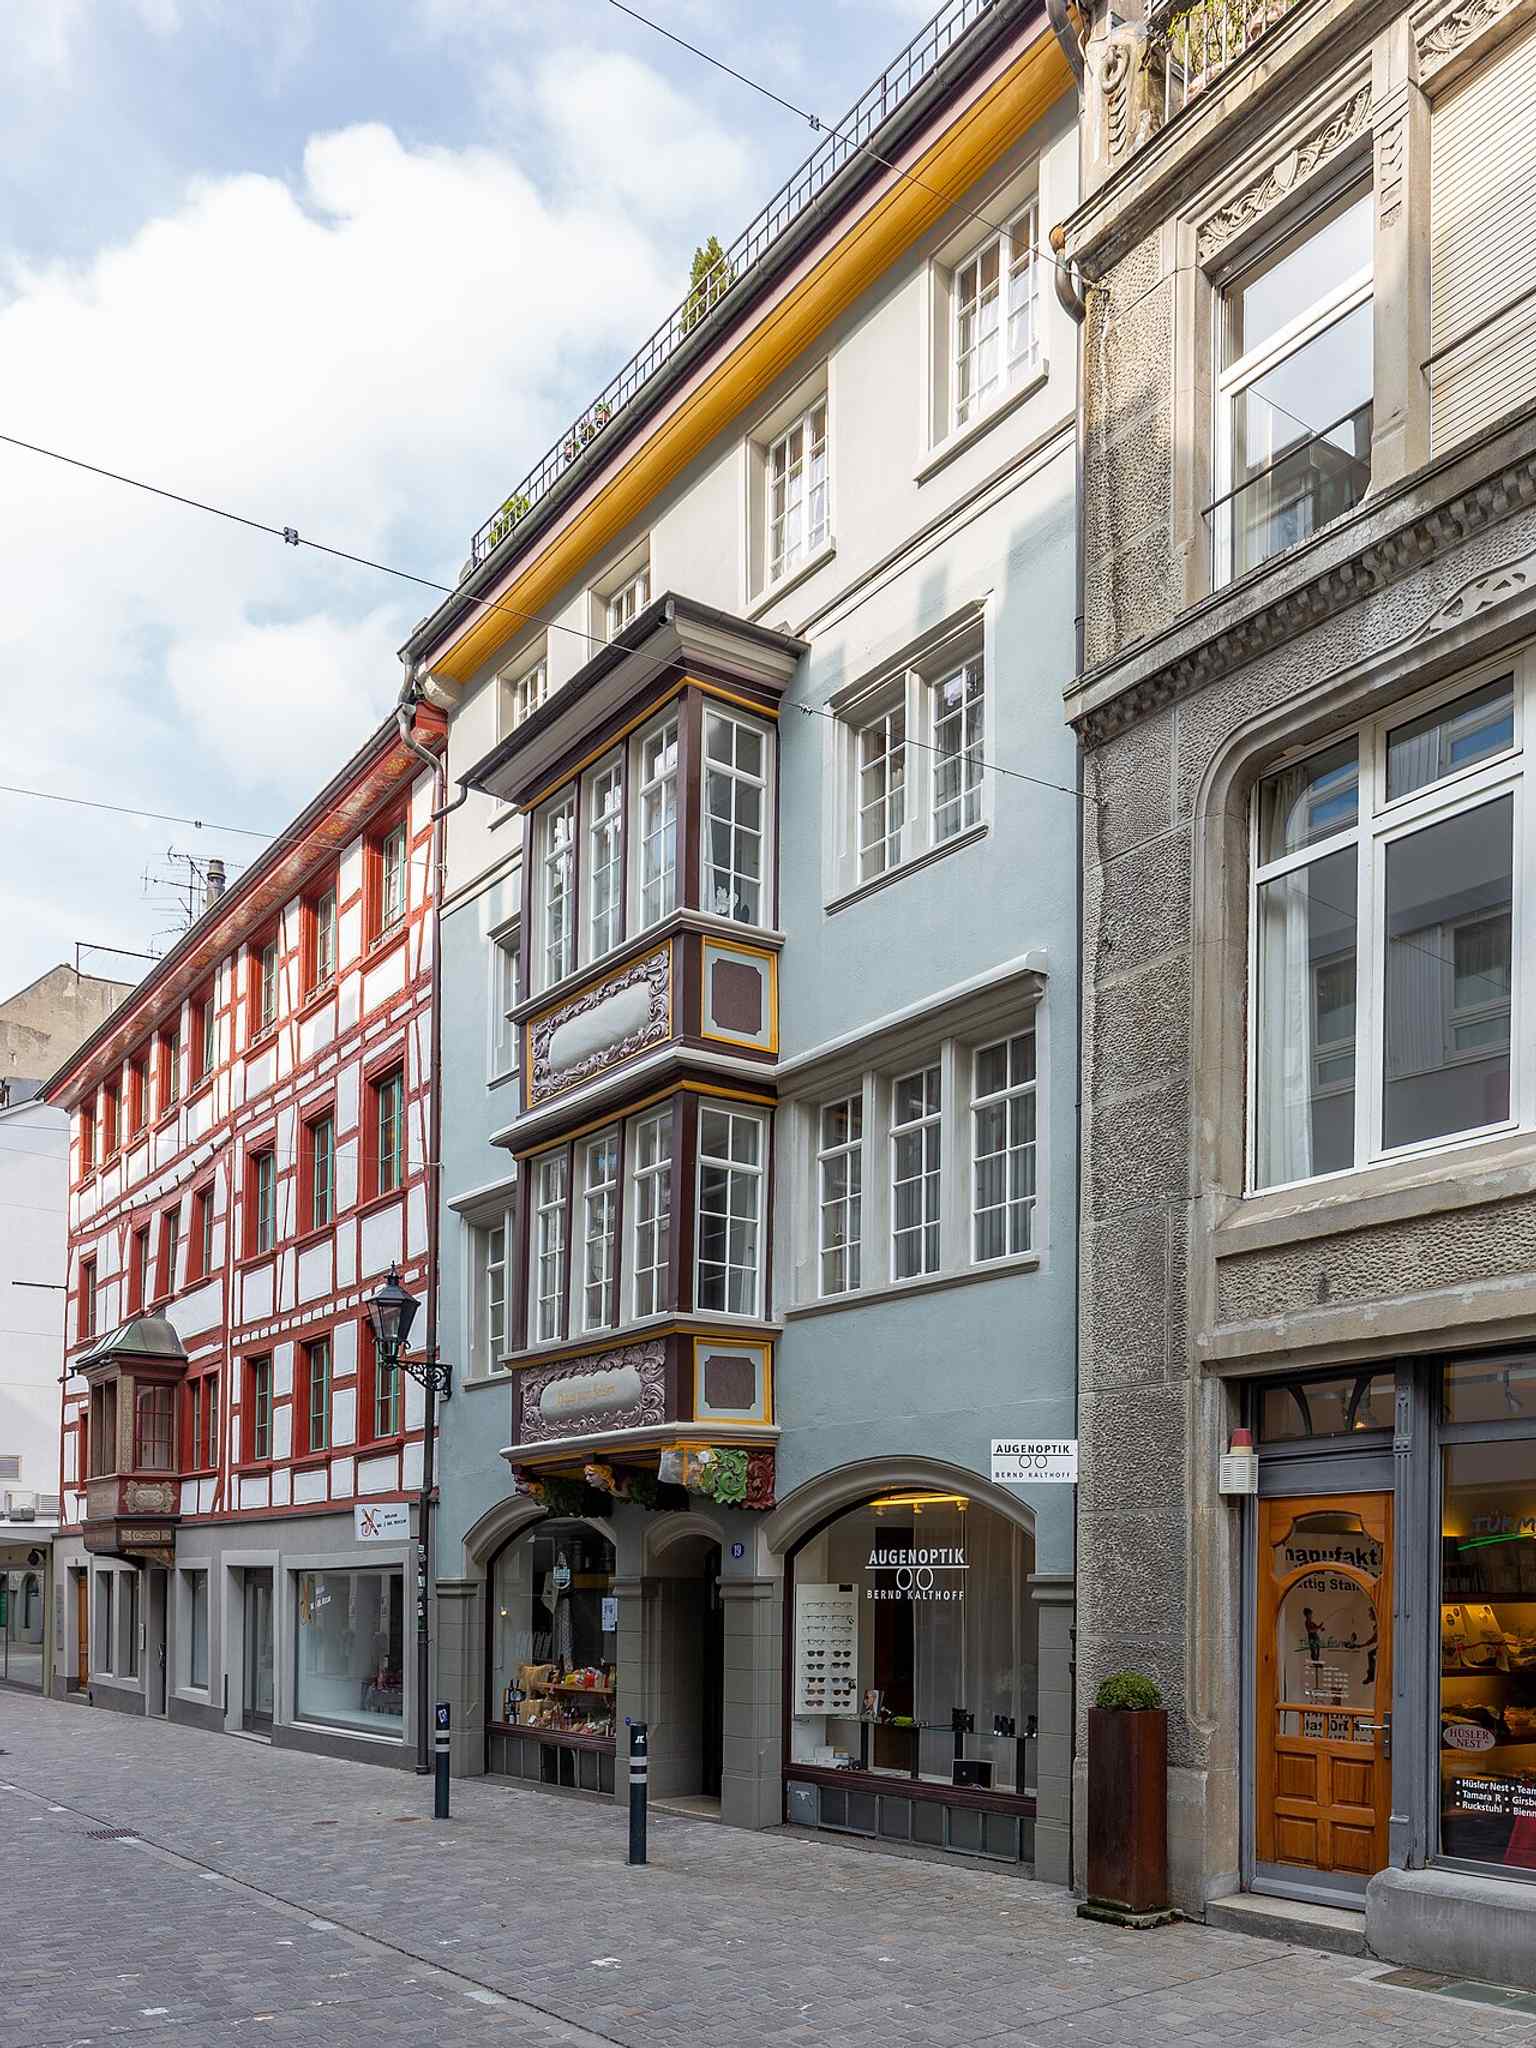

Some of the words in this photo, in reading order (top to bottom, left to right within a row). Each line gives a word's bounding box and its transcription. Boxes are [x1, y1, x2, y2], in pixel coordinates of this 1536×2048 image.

[996, 1444, 1070, 1454] AUGENOPTIK
[868, 1548, 965, 1565] AUGENOPTIK
[866, 1590, 902, 1600] BERND
[907, 1590, 965, 1600] KALTHOFF
[1462, 1779, 1488, 1790] Hüsler
[1490, 1782, 1509, 1793] Nest
[1462, 1790, 1492, 1801] Tamara
[1495, 1793, 1502, 1802] R
[1462, 1801, 1503, 1814] Ruckstuhl
